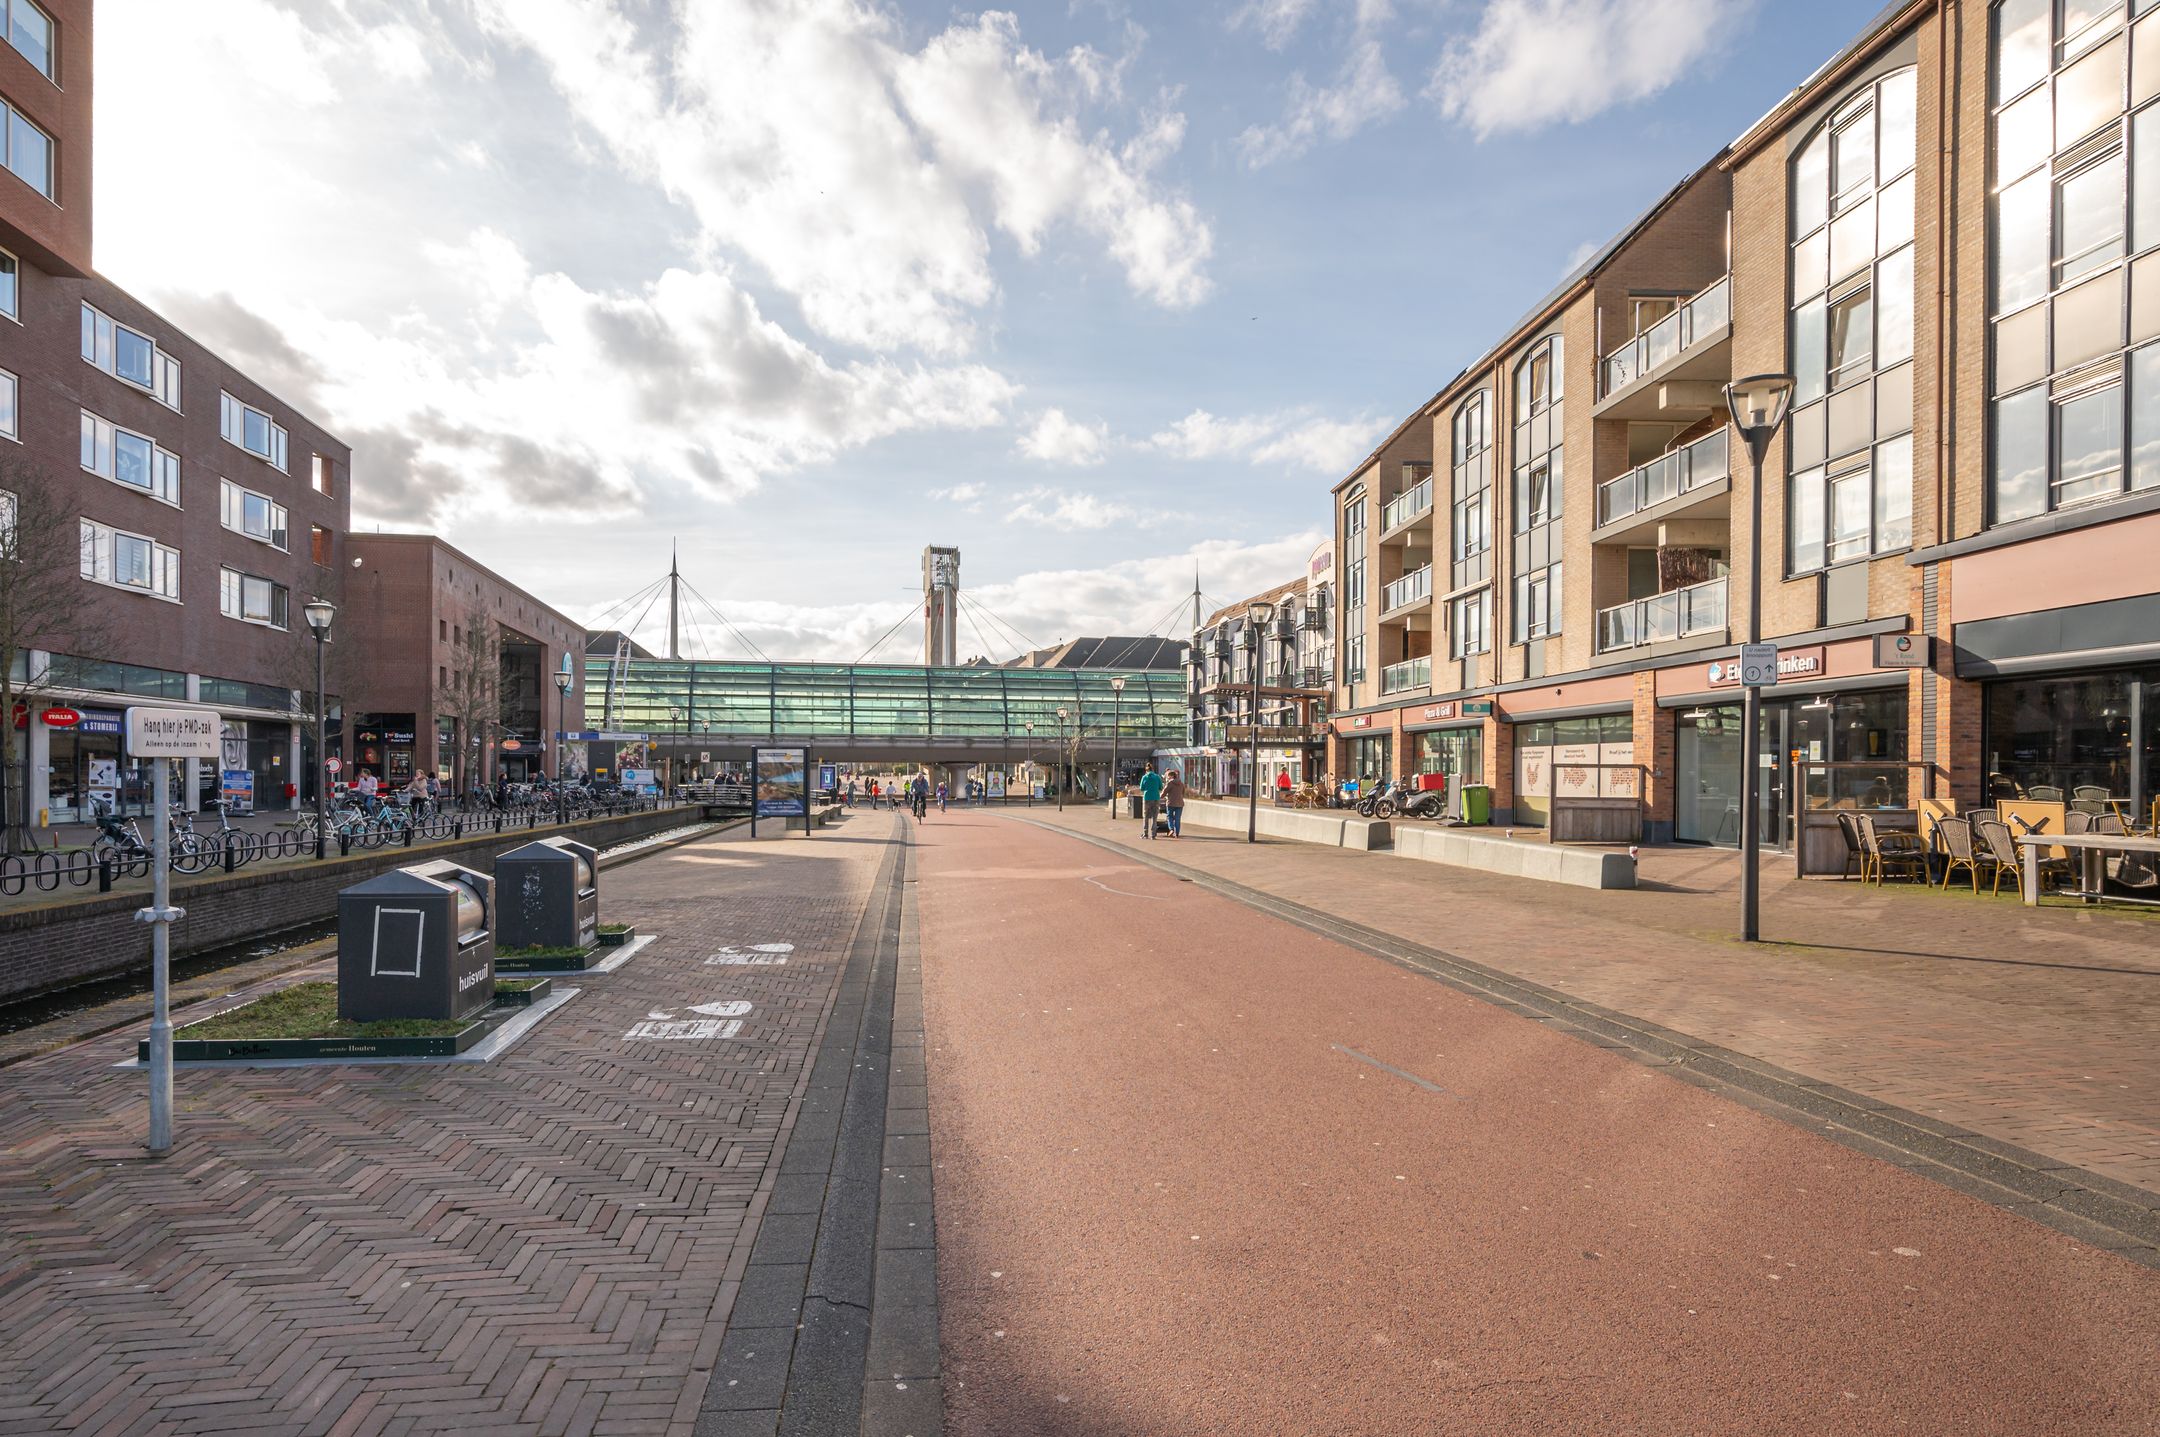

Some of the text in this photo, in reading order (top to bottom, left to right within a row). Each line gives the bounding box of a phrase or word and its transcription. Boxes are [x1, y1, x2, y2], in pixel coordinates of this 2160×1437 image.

[1777, 655, 1816, 674] rinken
[90, 722, 118, 731] STOMERIJ
[144, 717, 211, 738] Hang hier je PMD-zak
[459, 962, 489, 992] huisvuil
